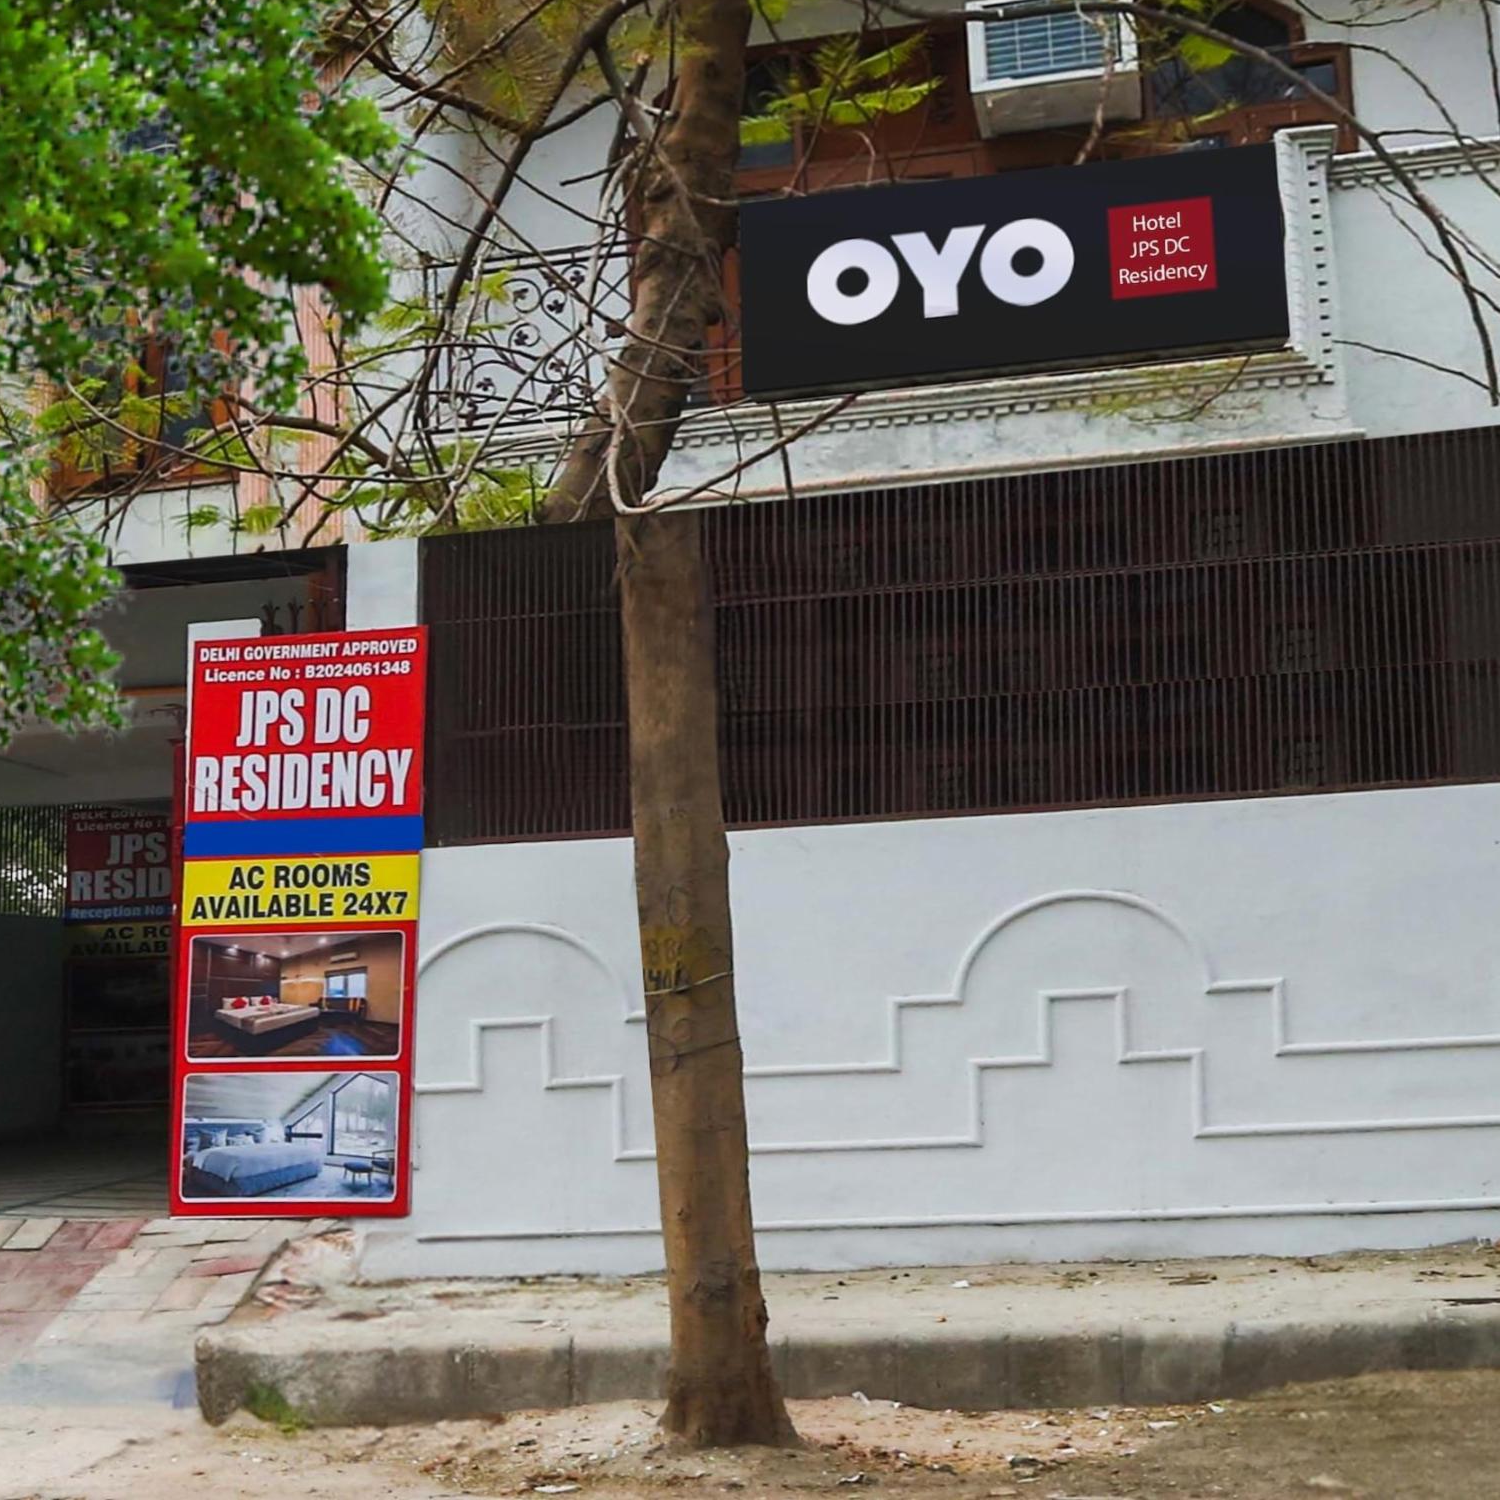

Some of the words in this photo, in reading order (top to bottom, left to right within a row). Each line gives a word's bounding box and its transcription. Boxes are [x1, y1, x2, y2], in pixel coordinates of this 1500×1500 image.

[1132, 211, 1181, 232] Hotel
[1129, 239, 1160, 258] JPS
[1164, 236, 1191, 255] DC
[806, 217, 1075, 325] OYO
[1119, 264, 1208, 284] Residency
[200, 647, 240, 662] DELHI
[244, 642, 339, 661] GOVERNMENT
[342, 638, 417, 656] APPROVED
[204, 667, 265, 682] Licence
[269, 666, 291, 680] No
[305, 660, 410, 678] B2024061348
[236, 688, 305, 747] JPS
[314, 685, 370, 744] DC
[193, 748, 413, 812] RESIDENCY
[76, 821, 130, 832] Licence
[106, 832, 167, 865] JPS
[229, 866, 265, 890] AC
[274, 862, 371, 889] ROOMS
[71, 904, 140, 919] Reception
[145, 905, 164, 916] No
[191, 892, 334, 920] AVAILABLE
[342, 891, 408, 916] 24X7
[102, 926, 134, 940] AC
